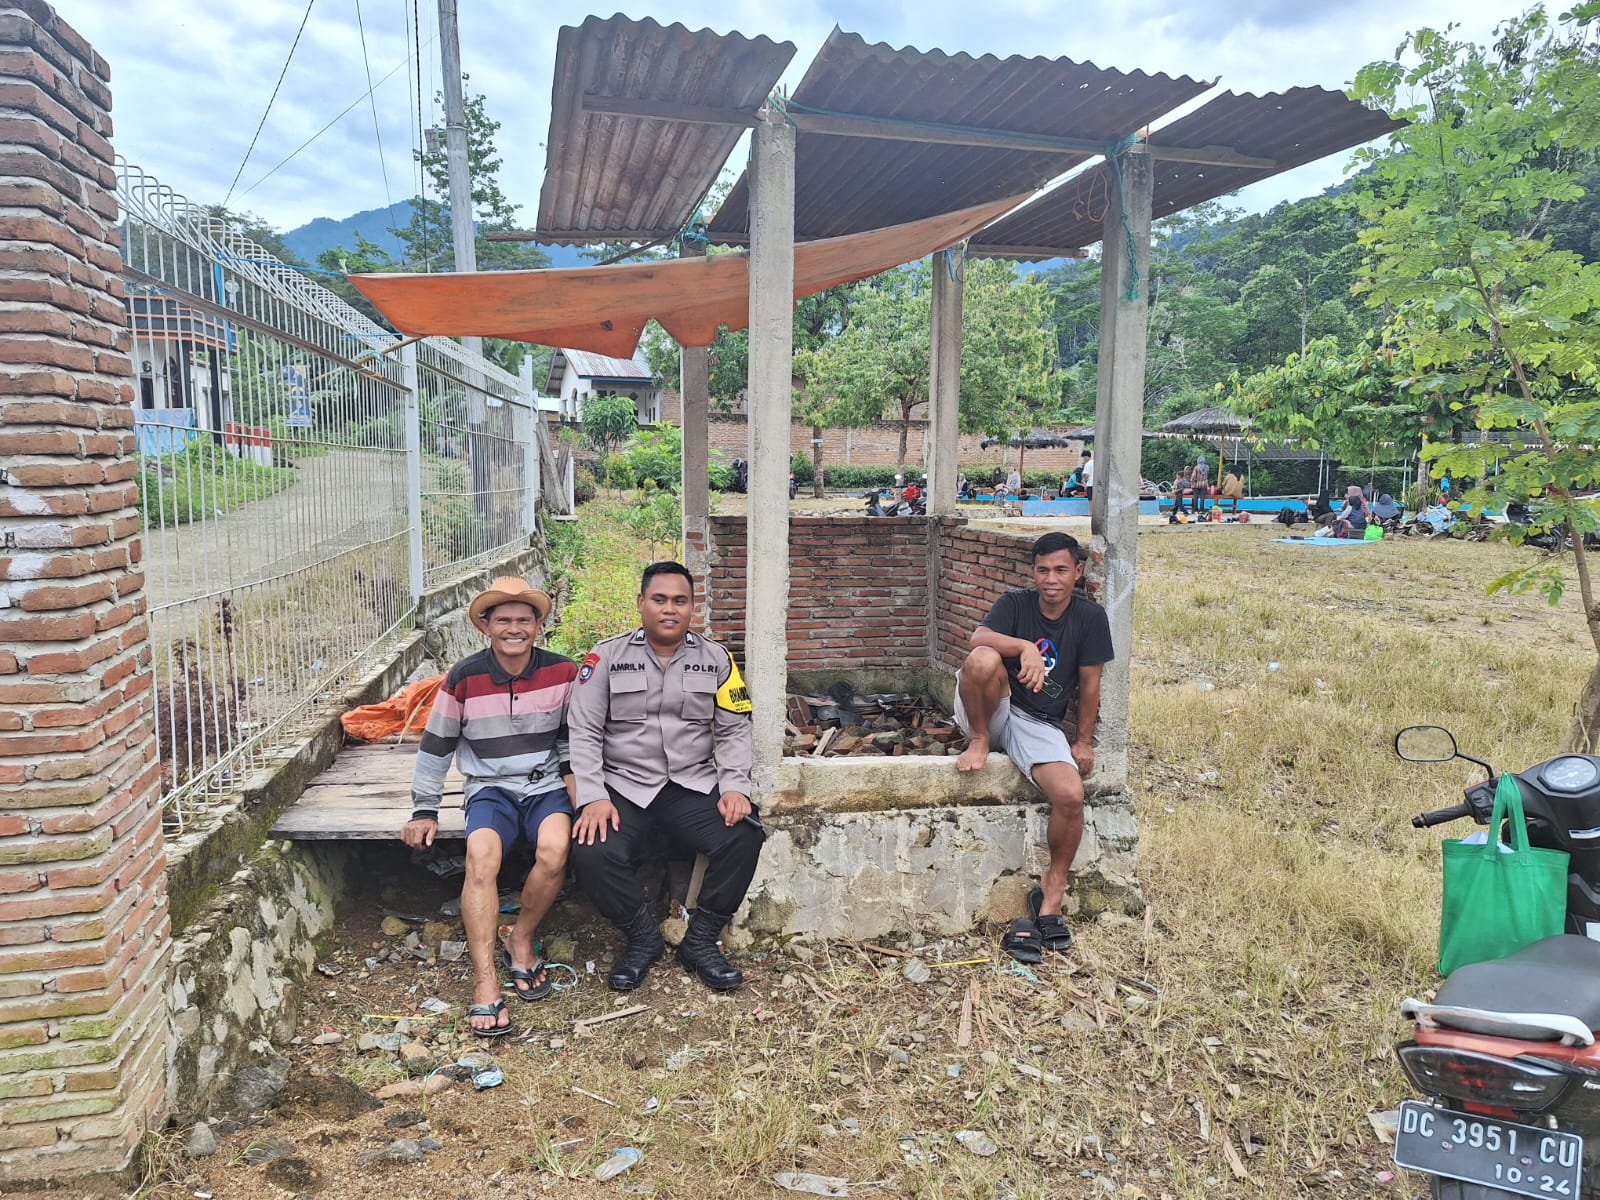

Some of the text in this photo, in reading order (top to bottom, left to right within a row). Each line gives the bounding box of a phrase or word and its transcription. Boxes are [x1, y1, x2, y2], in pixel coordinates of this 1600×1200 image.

[684, 664, 718, 673] POLRI
[1403, 1108, 1576, 1167] DC 3951 CU
